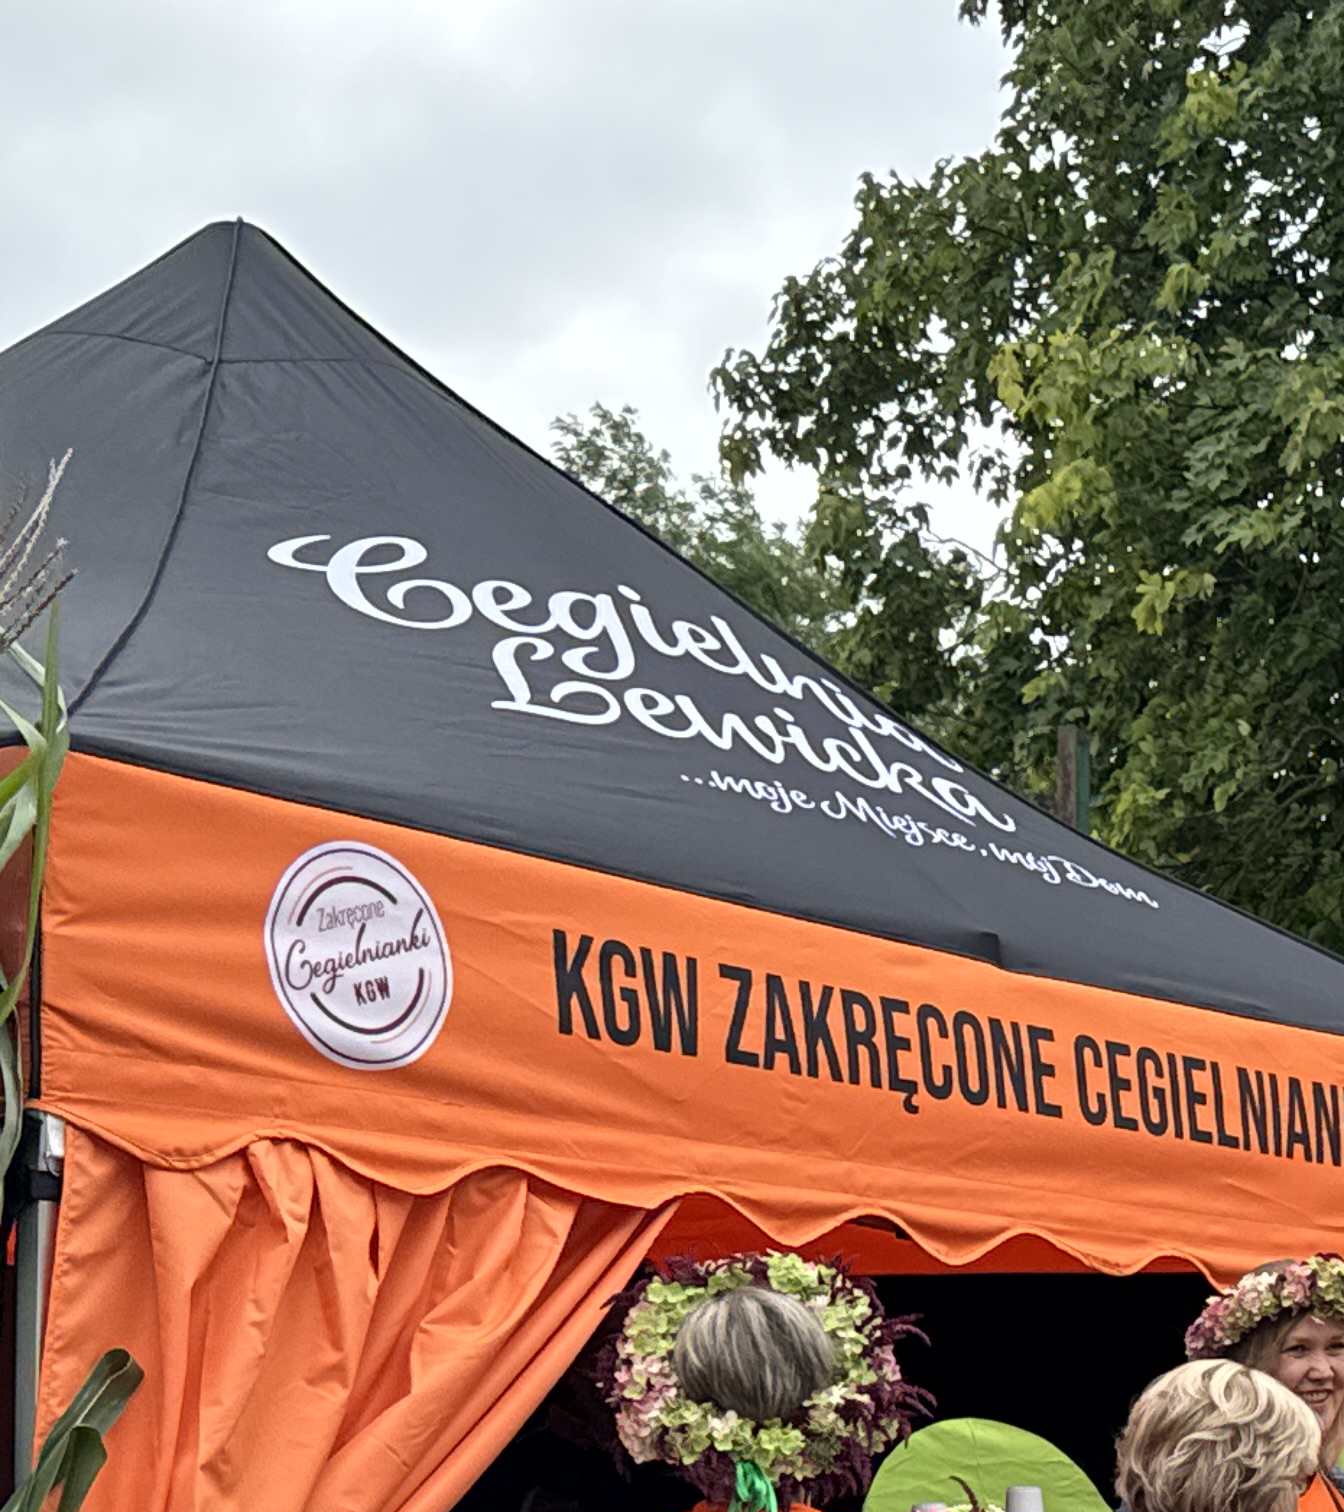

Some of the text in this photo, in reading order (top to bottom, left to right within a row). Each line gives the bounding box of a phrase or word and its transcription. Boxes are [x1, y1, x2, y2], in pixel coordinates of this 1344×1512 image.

[267, 533, 964, 773] Cegielnia
[490, 635, 1017, 833] Lewicka
[1047, 855, 1160, 909] Dom
[284, 907, 431, 995] Cegielnianki
[353, 975, 391, 1006] KGW
[552, 929, 699, 1058] KGW
[717, 962, 1063, 1115] ZAKRĘCONE
